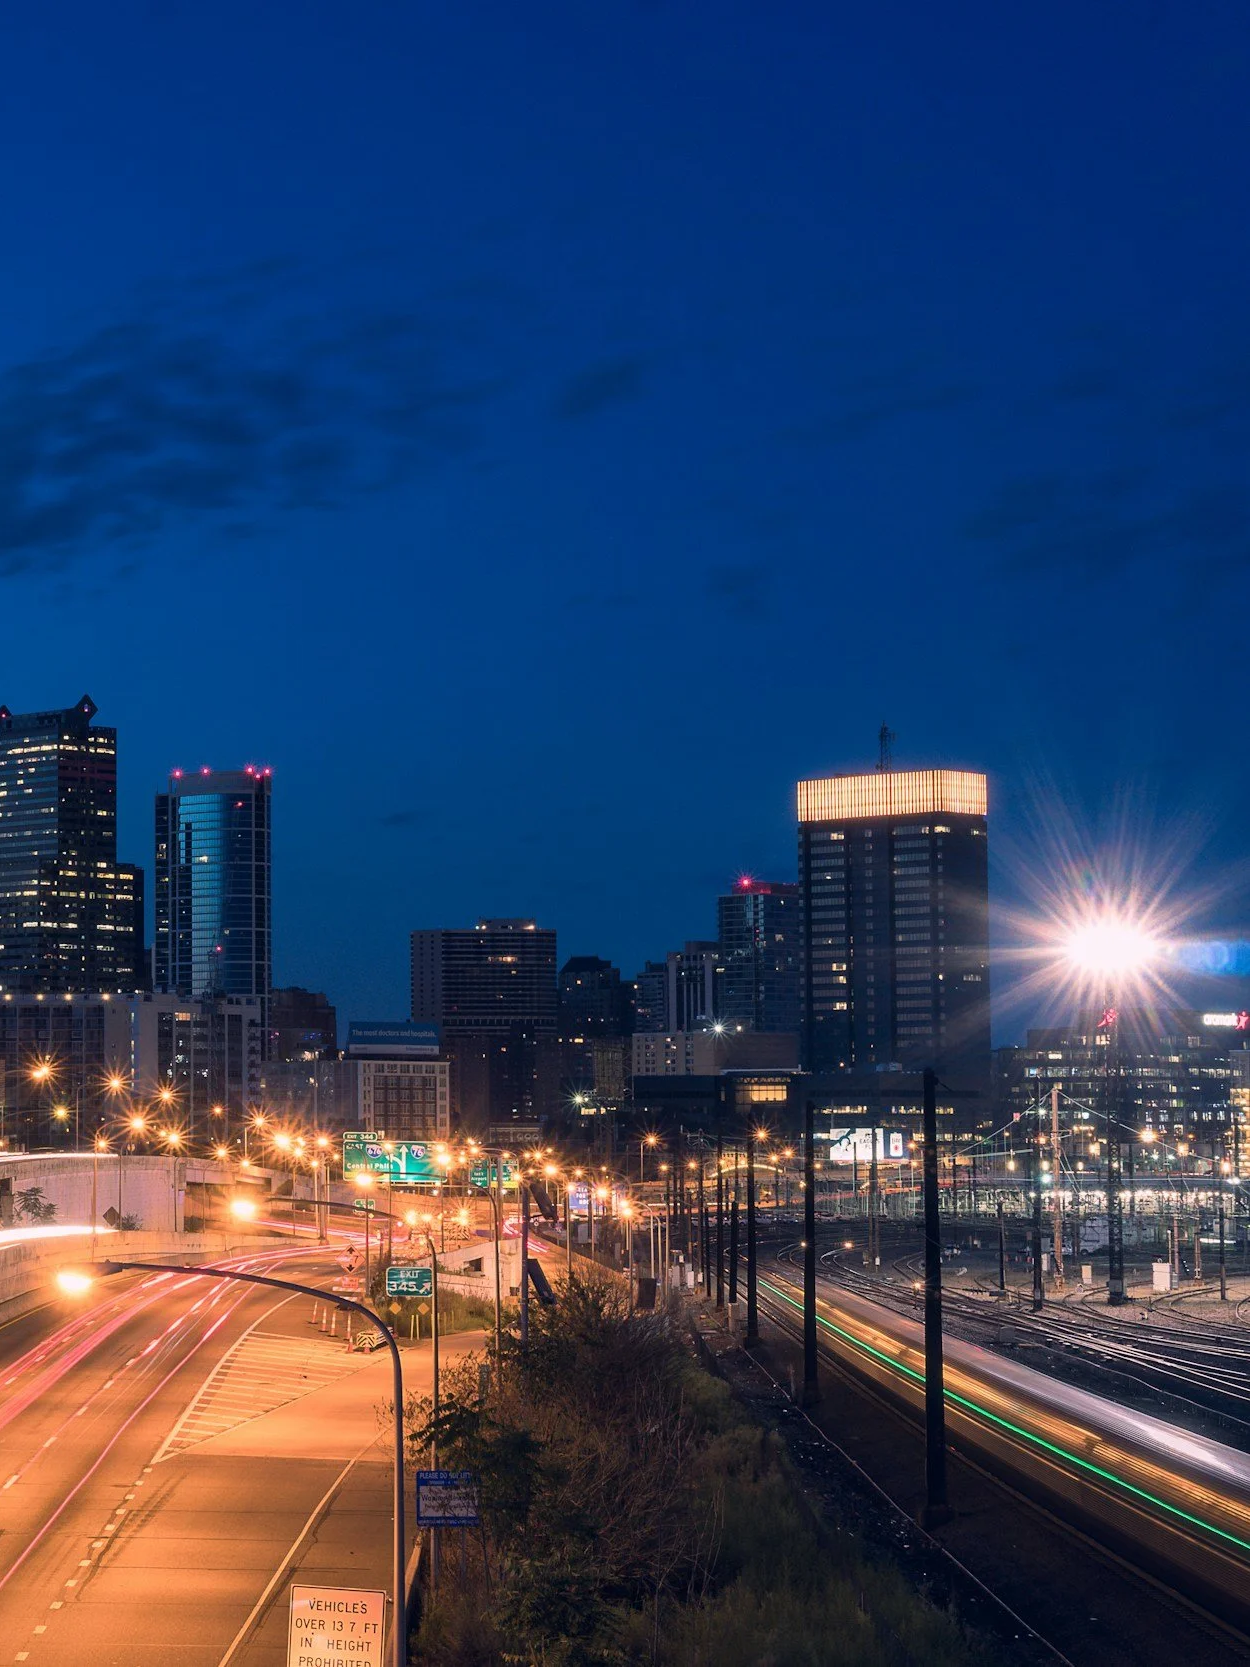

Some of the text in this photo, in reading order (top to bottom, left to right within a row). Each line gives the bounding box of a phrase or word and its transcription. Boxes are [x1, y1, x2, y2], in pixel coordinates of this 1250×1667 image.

[368, 1146, 381, 1155] 676
[400, 1270, 419, 1278] EXIT
[389, 1281, 416, 1291] 345
[309, 1600, 367, 1614] VEHICLES
[295, 1618, 325, 1630] OVER
[364, 1623, 378, 1633] FT
[300, 1637, 371, 1651] IN HEIGHT
[299, 1656, 371, 1667] PROHIBITED
